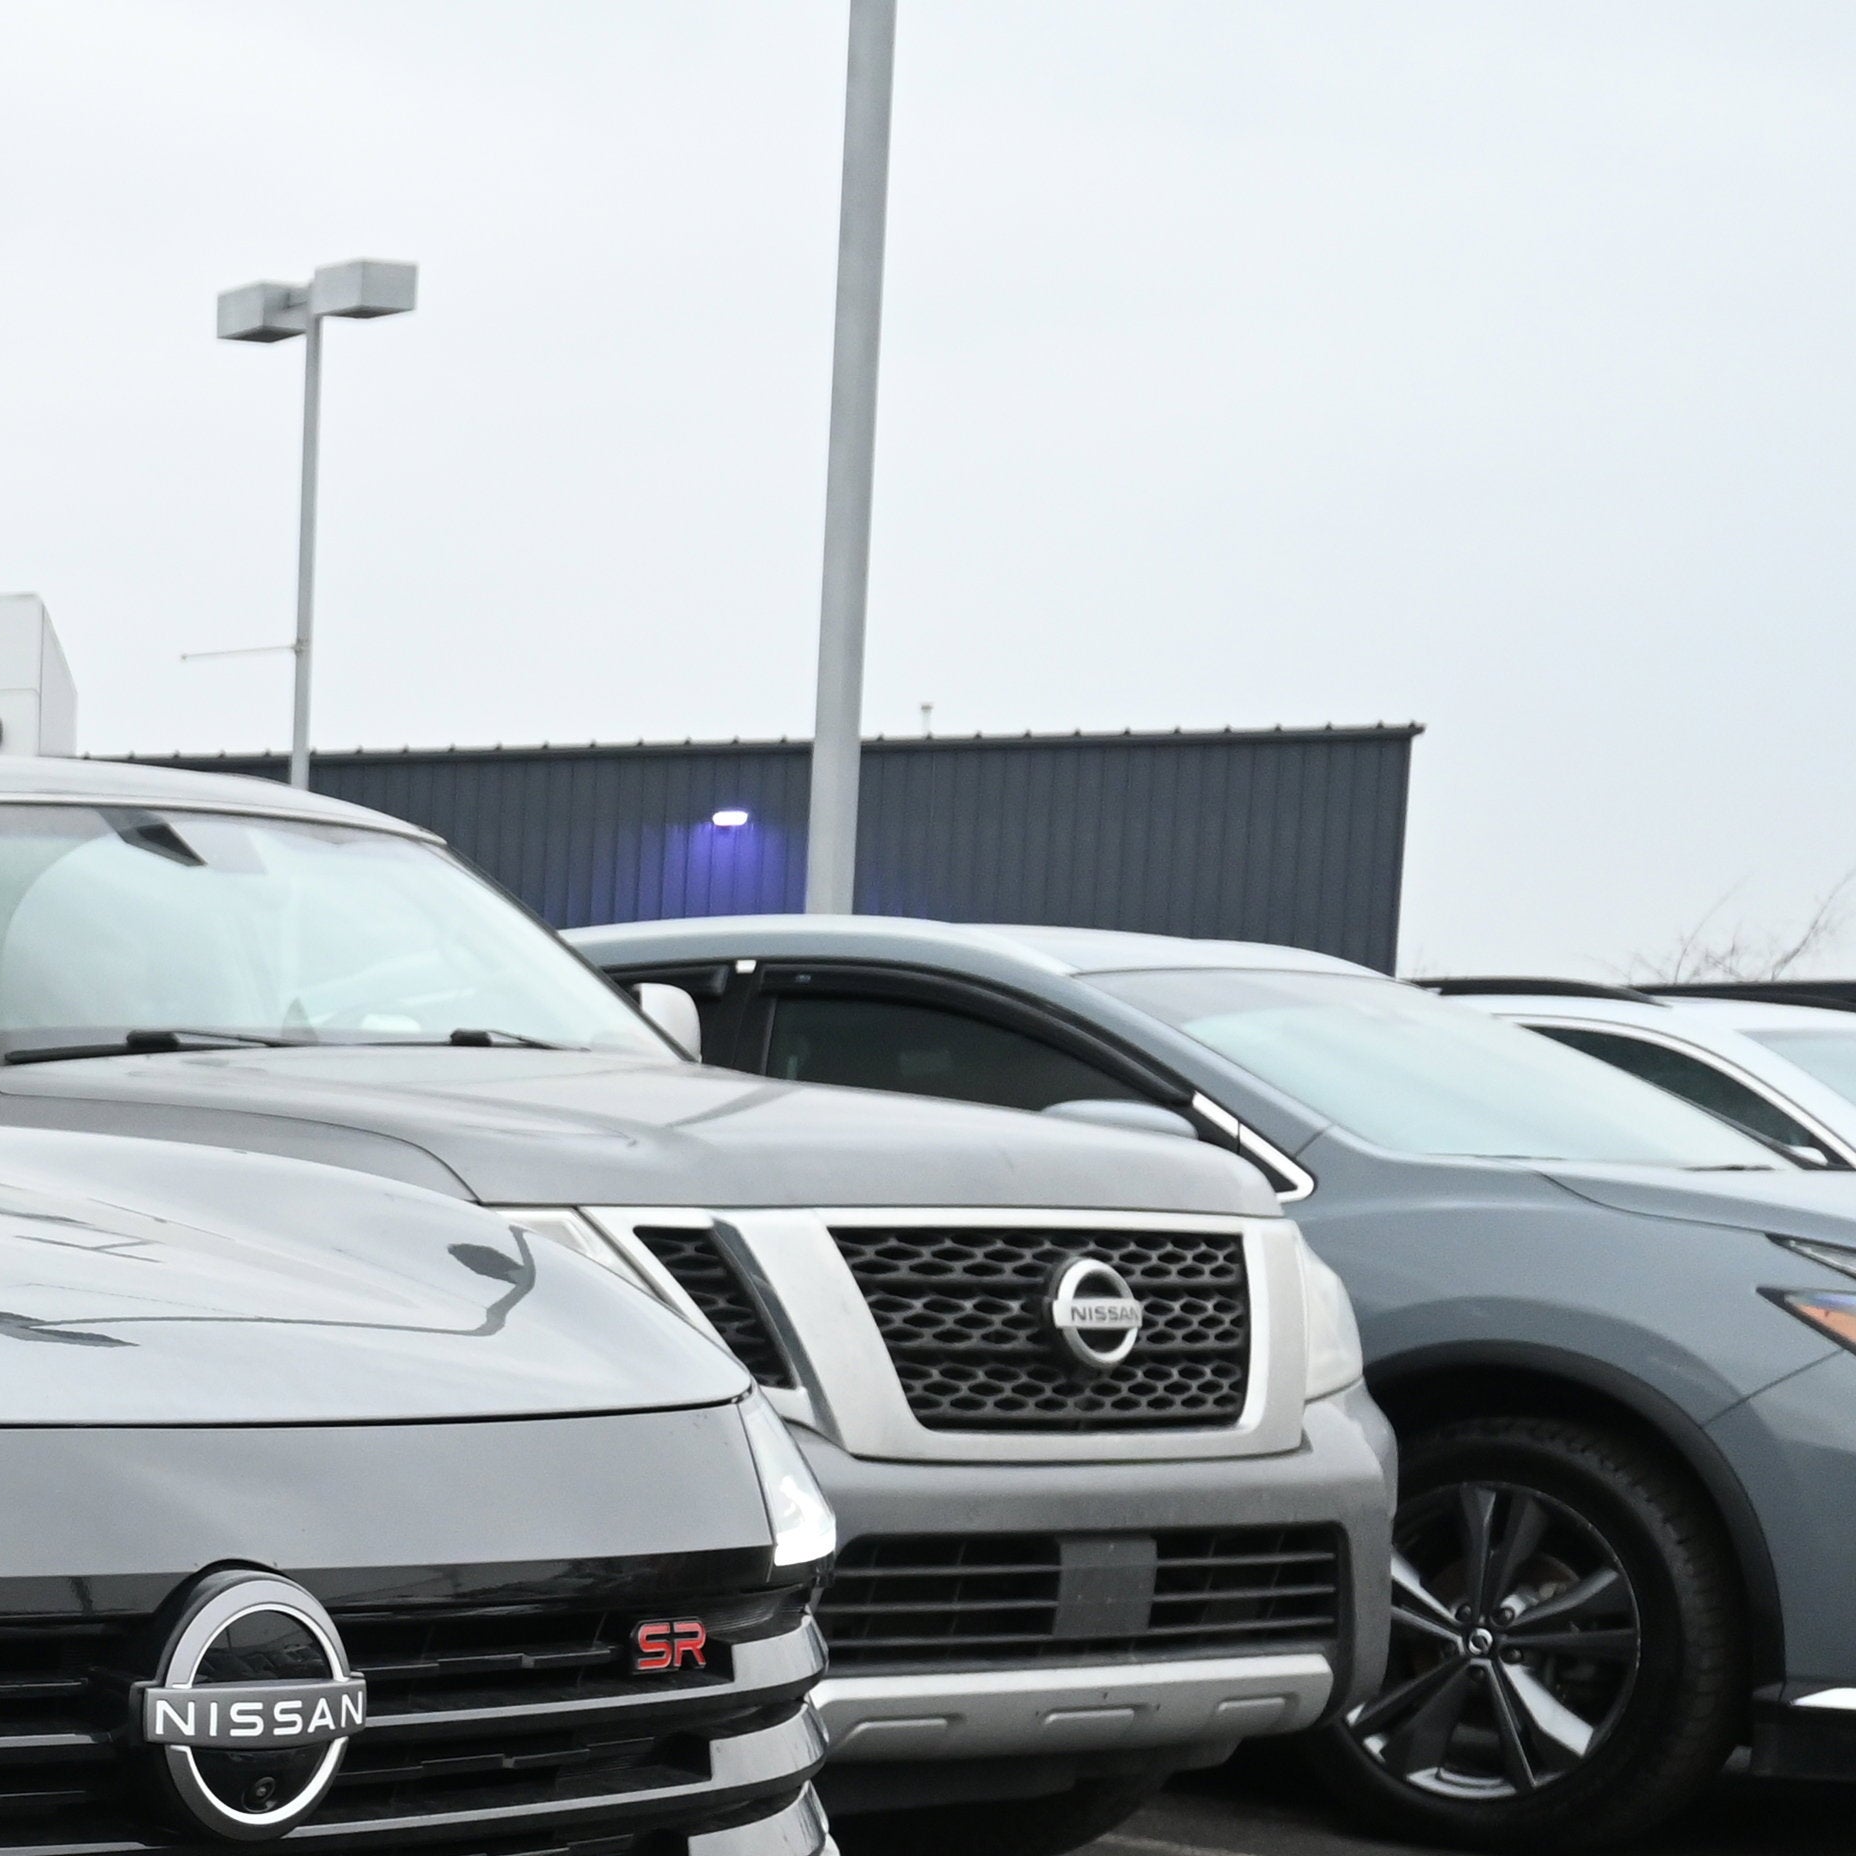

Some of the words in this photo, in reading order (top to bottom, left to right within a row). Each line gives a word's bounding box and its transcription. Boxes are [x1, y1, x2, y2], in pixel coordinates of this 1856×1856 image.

[1070, 1305, 1139, 1321] NISSAN
[636, 1621, 707, 1670] SR
[155, 1690, 363, 1737] NISSAN
